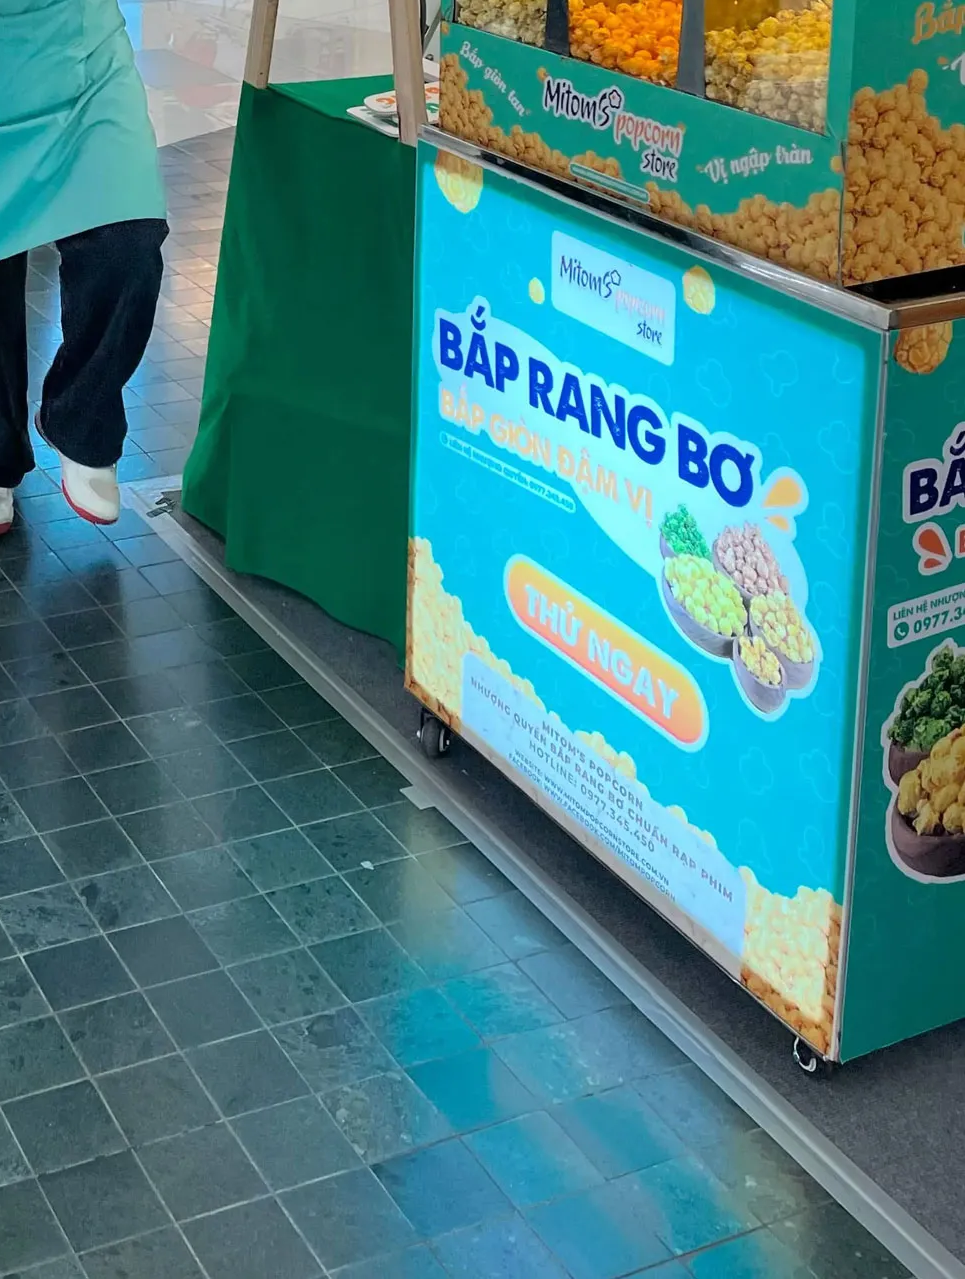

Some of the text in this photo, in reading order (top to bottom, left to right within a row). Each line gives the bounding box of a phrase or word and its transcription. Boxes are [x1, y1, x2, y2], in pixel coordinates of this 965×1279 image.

[615, 114, 681, 154] popcorn
[642, 150, 676, 179] store
[730, 147, 772, 177] ngập
[776, 143, 814, 165] tràn
[636, 320, 663, 346] store
[439, 305, 755, 507] BẮP RANG BƠ
[441, 381, 484, 428] BẮP
[490, 413, 552, 467] GIÒN
[624, 477, 654, 529] VỊ
[524, 583, 680, 719] THỬ NGAY
[893, 607, 914, 620] LIÊN
[915, 600, 928, 613] HỆ
[471, 677, 511, 716] NHƯỢNG
[574, 763, 605, 794] RANG
[672, 843, 696, 868] RẠP
[701, 868, 733, 903] PHIM
[529, 740, 655, 853] HOTLINE: 0977.345.450
[542, 721, 643, 810] MITOM'S POPCORN
